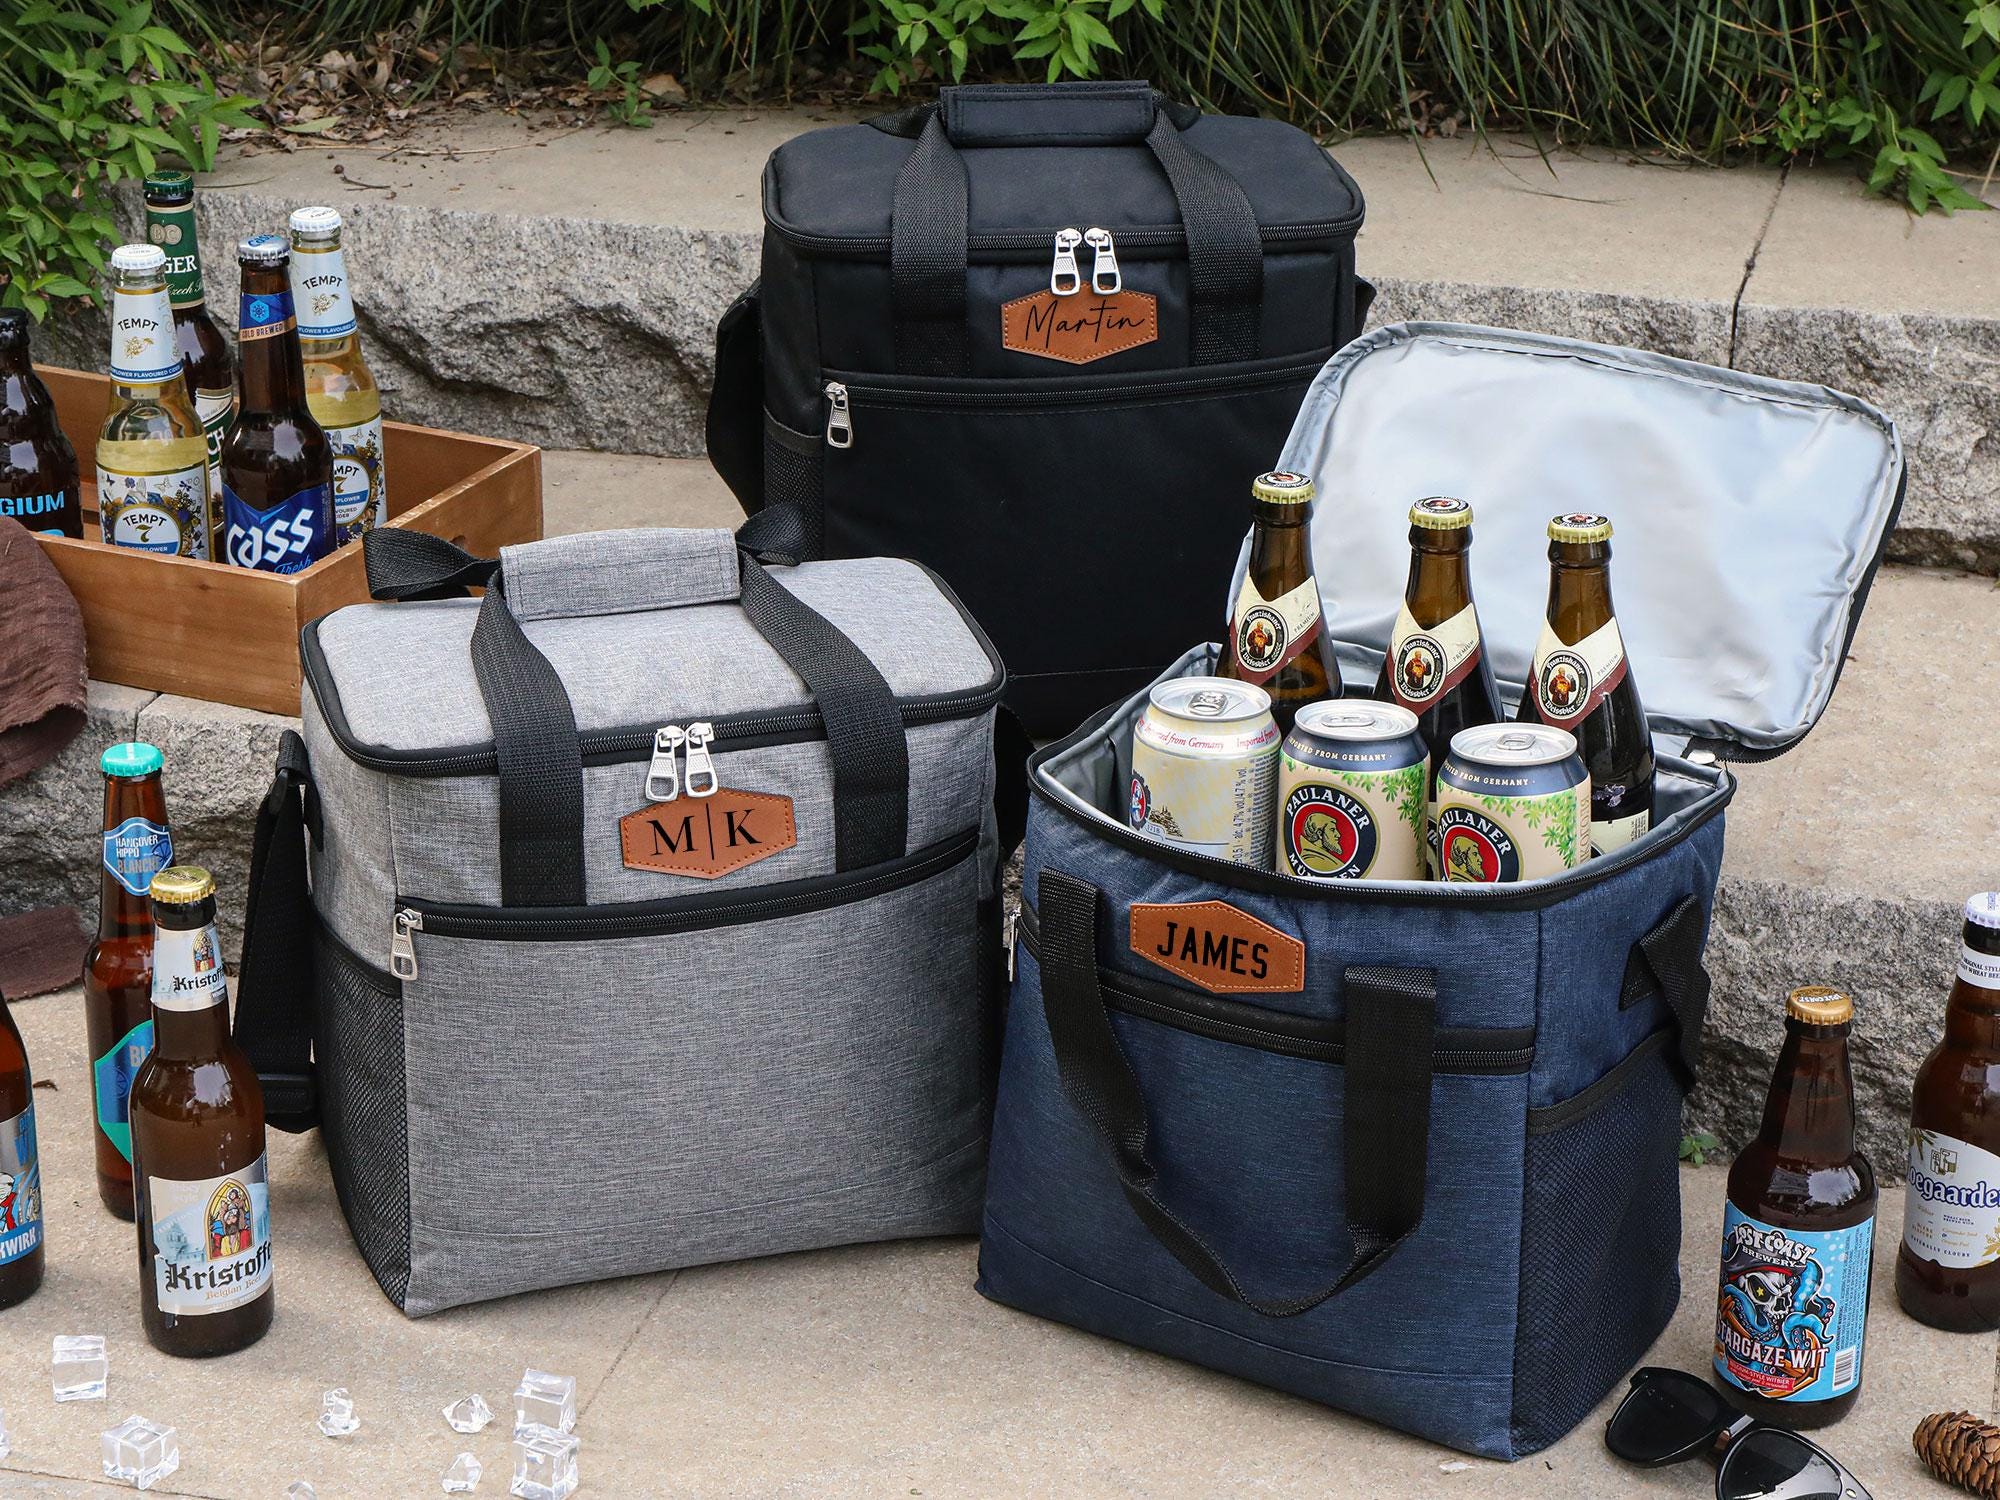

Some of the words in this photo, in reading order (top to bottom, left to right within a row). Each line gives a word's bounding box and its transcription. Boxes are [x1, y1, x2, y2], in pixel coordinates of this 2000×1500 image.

[164, 255, 197, 273] GER
[302, 275, 343, 290] TEMPT
[118, 318, 159, 332] TEMPT
[1025, 299, 1146, 348] Martin
[335, 465, 360, 476] MPT
[335, 506, 358, 514] VOURED
[123, 513, 167, 526] TEMPT
[1294, 611, 1316, 634] PREMIUM
[1452, 639, 1475, 662] PREMIUM
[1165, 732, 1186, 746] from
[1188, 737, 1224, 749] Germany
[1315, 749, 1339, 760] FROM
[1342, 753, 1387, 762] GERMANY
[1460, 771, 1480, 783] FROM
[1484, 777, 1530, 786] GERMANY
[1287, 788, 1370, 830] PAULANER
[116, 834, 158, 848] HANGOVER
[1438, 809, 1511, 856] PAULANER
[116, 847, 140, 858] HIPPO
[1156, 921, 1269, 980] JAMES
[1908, 1165, 2000, 1208] oegaarde
[1742, 1244, 1797, 1268] BREWERY
[206, 1284, 242, 1300] Belgian
[245, 1274, 262, 1289] Beer
[1716, 1313, 1786, 1368] STARGAZE
[1790, 1347, 1830, 1370] WIT
